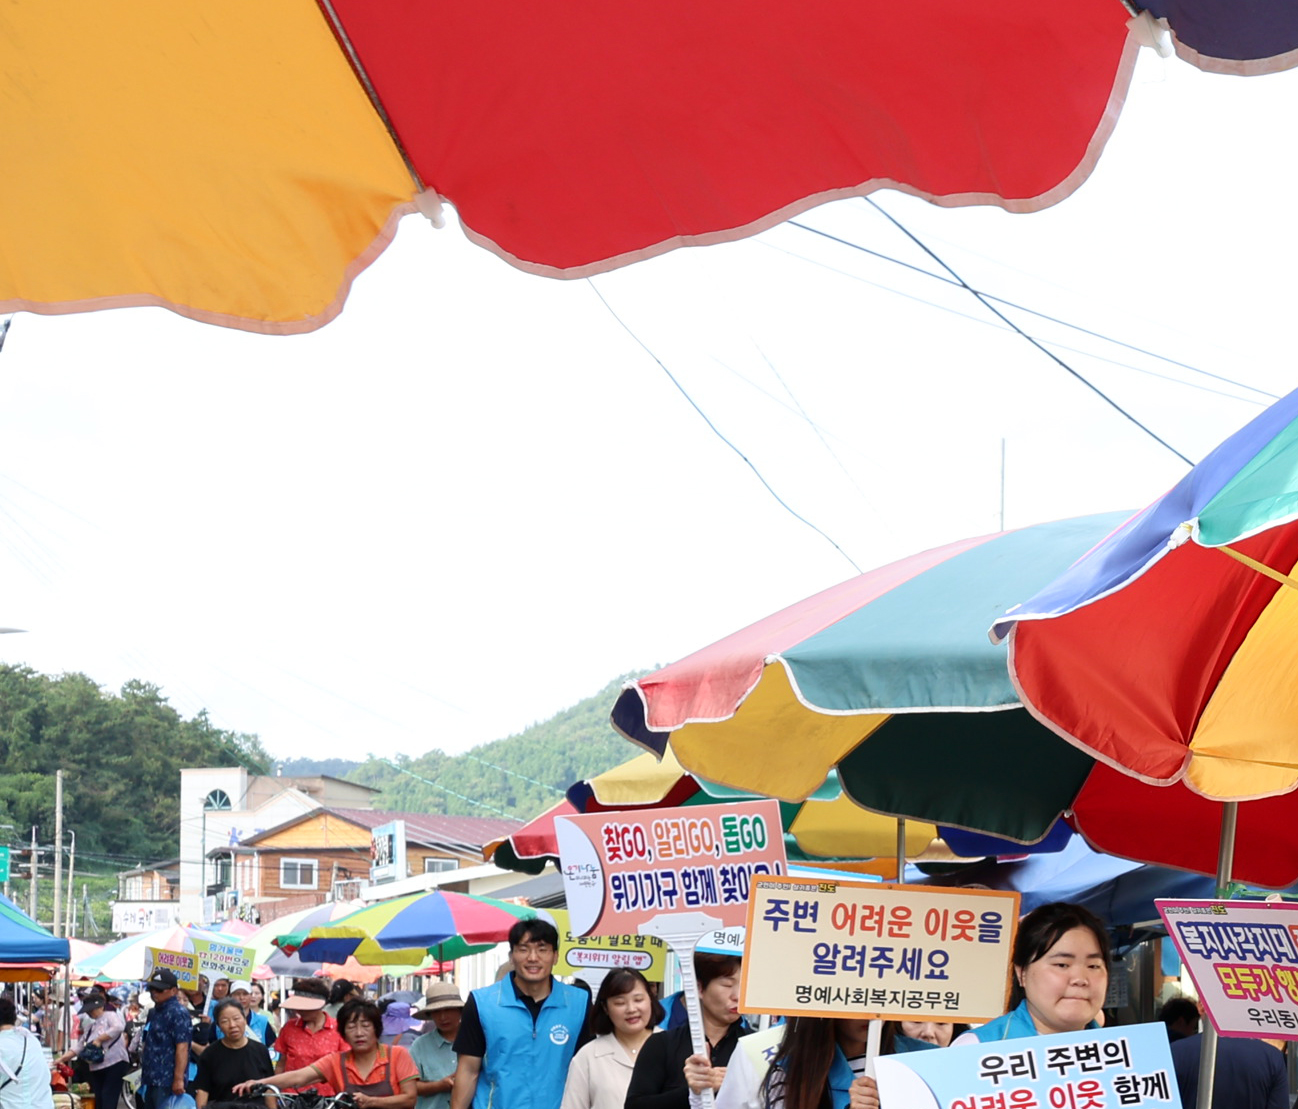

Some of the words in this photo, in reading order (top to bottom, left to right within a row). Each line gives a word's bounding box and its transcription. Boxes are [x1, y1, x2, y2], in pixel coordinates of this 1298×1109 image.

[603, 824, 653, 862] 찾GO,
[654, 818, 721, 859] 알리GO,
[721, 815, 766, 854] 돕GO
[610, 869, 678, 912] 위기가구
[680, 867, 718, 906] 함께
[818, 883, 836, 893] 진도
[714, 931, 745, 947] 명예
[763, 899, 819, 933] 주변
[831, 902, 913, 939] 어려운
[924, 908, 1004, 944] 이웃을
[608, 934, 645, 948] 필요할
[651, 936, 662, 948] 때
[1178, 923, 1298, 962] 복지사각지대
[201, 960, 243, 975] 전화주세요
[612, 954, 630, 965] 알림
[812, 942, 950, 981] 알려주세요
[795, 984, 960, 1011] 명예사회복지공무원
[1216, 965, 1282, 1001] 모두가
[980, 1050, 1037, 1085] 우리
[1046, 1039, 1131, 1076] 주변의
[1113, 1071, 1170, 1105] 함께
